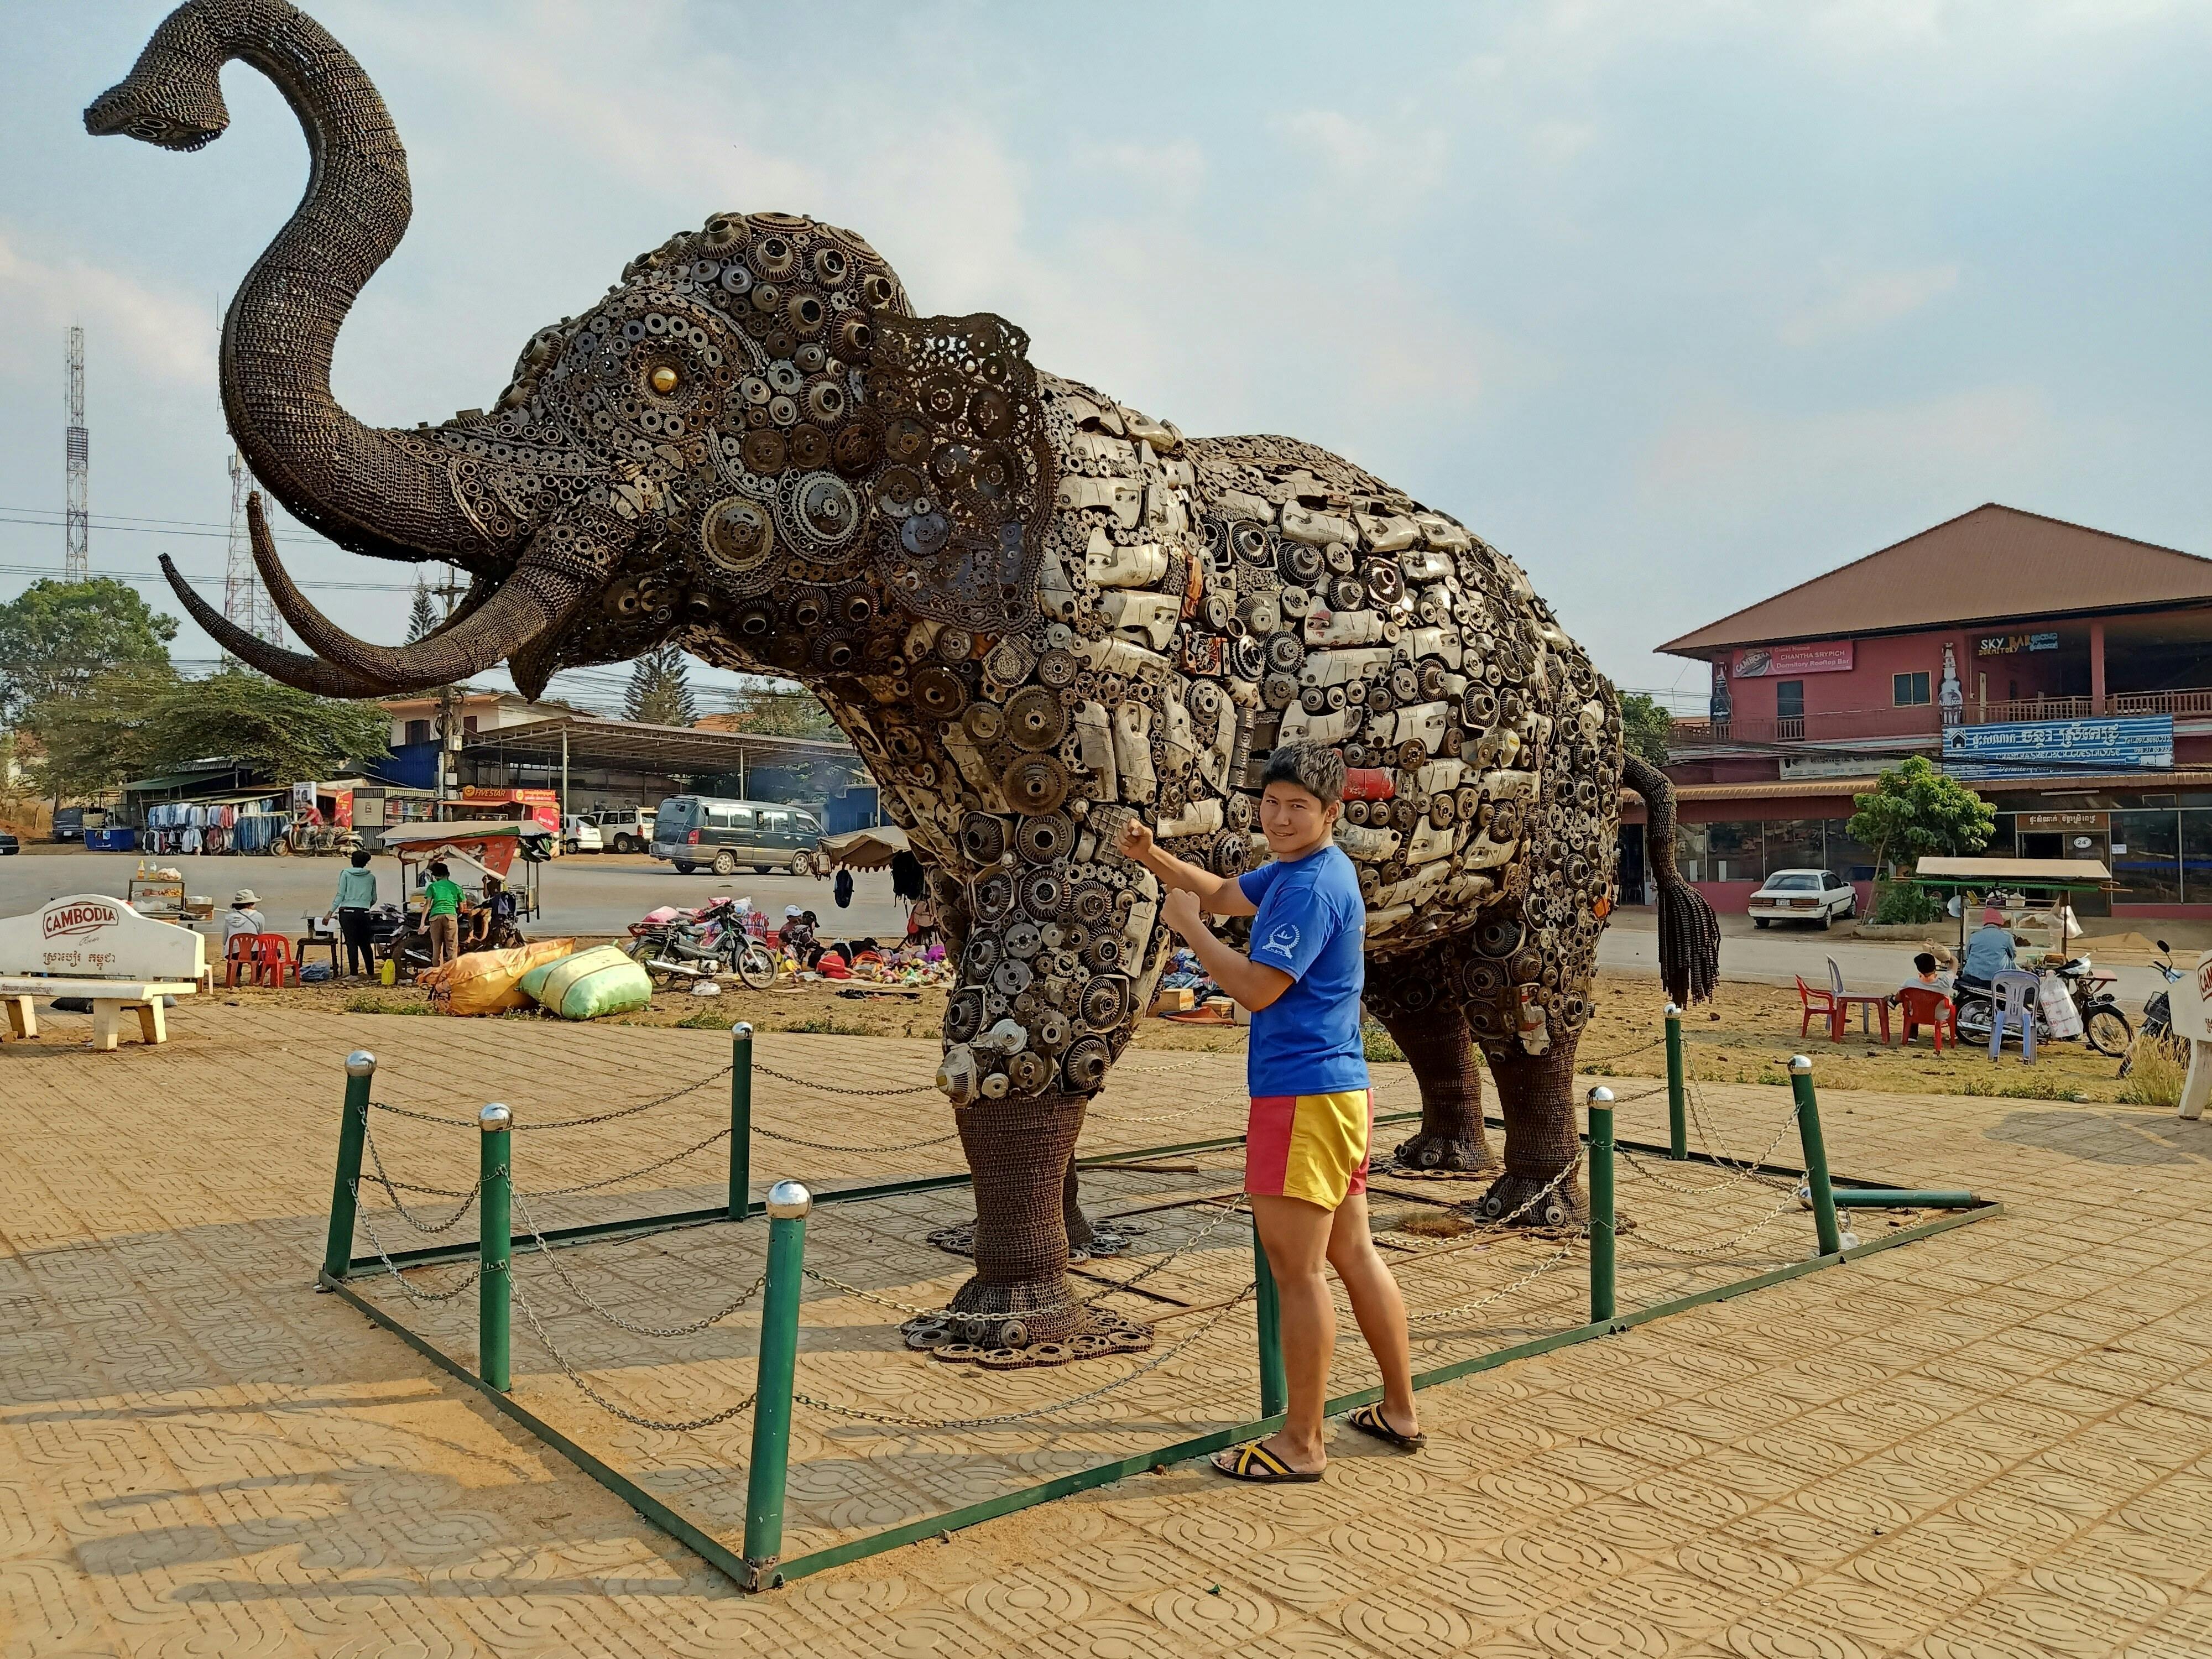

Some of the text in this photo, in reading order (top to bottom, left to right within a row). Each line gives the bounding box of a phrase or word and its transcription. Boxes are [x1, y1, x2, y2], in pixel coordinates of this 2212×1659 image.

[1981, 638, 2004, 649] SKY
[2008, 635, 2030, 647] BAR
[1979, 646, 2018, 655] DORMITORY
[46, 907, 116, 932] CAMBODIA
